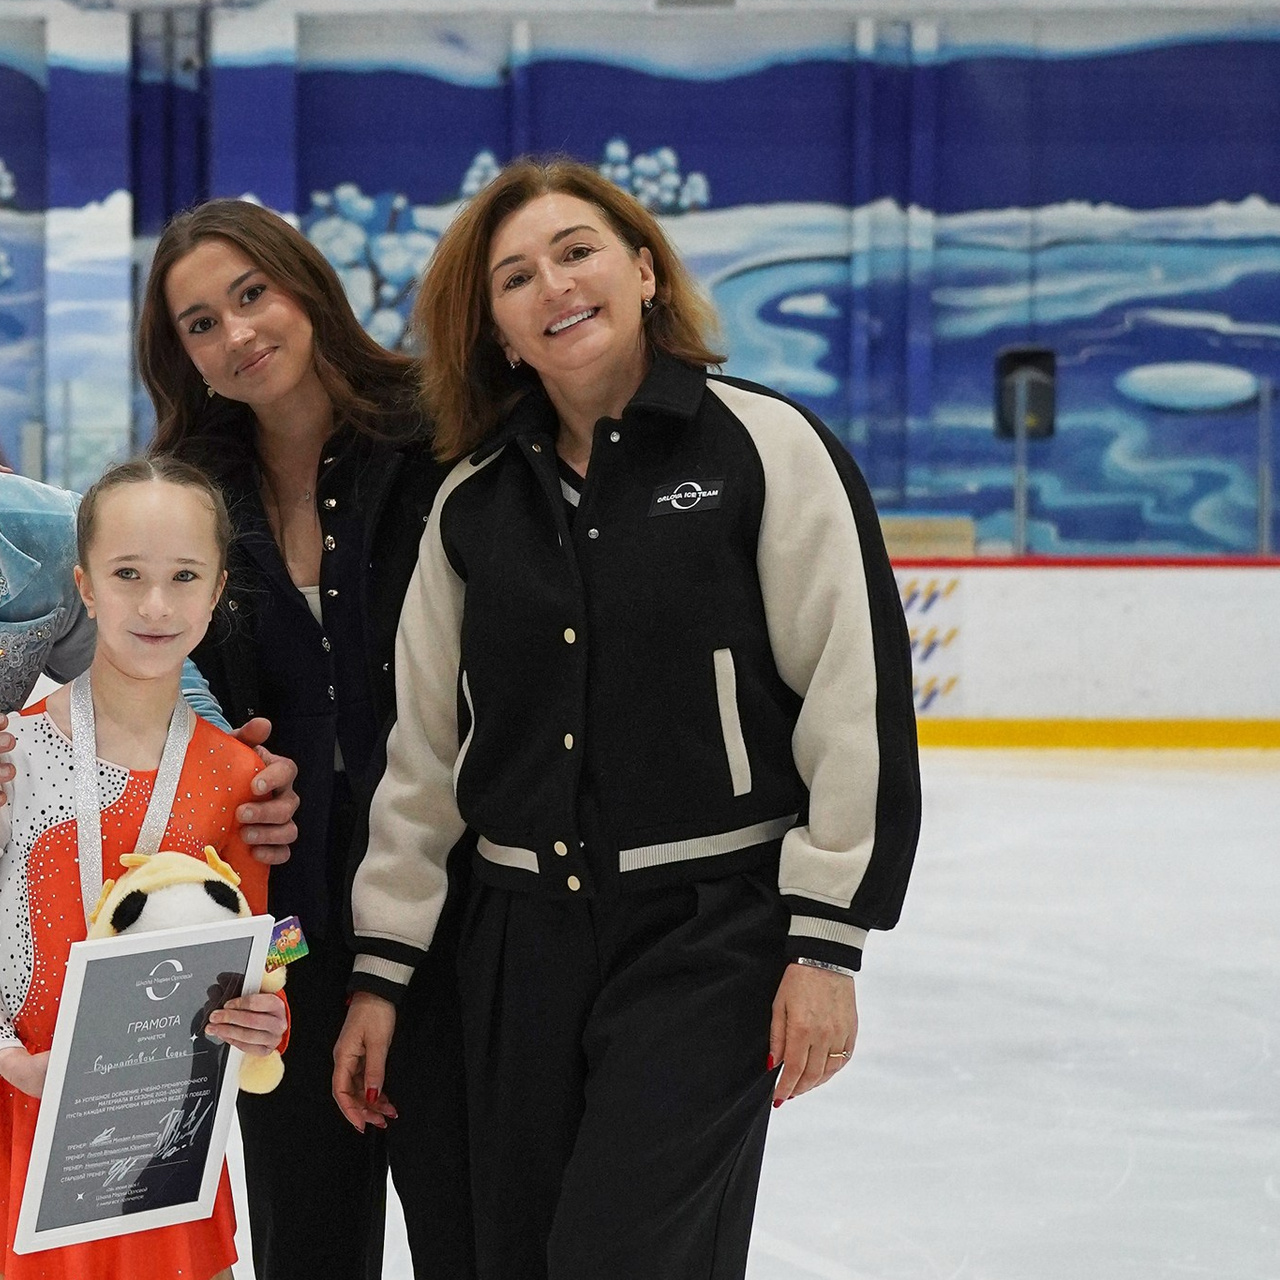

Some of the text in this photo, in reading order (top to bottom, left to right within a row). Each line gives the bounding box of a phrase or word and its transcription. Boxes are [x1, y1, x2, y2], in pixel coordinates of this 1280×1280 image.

[656, 489, 719, 503] ORLOVA ICE TEAM
[127, 1015, 180, 1033] ГРАМОТА
